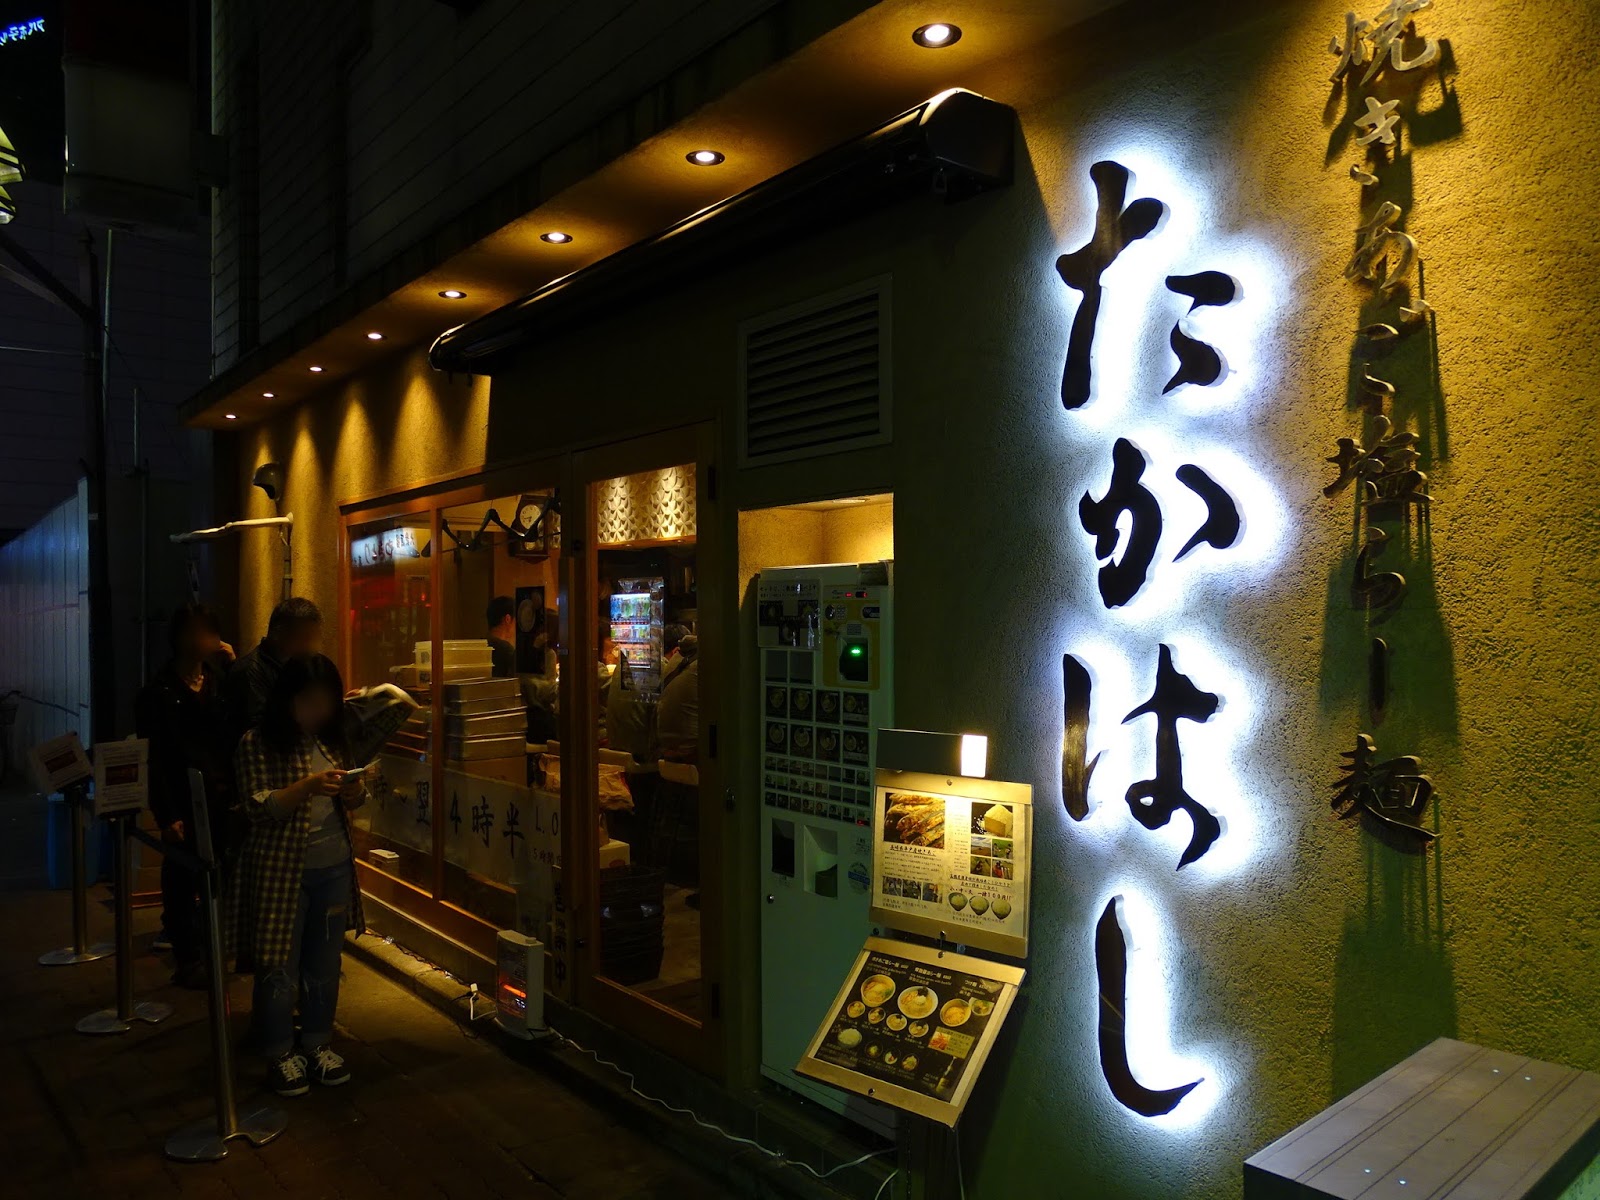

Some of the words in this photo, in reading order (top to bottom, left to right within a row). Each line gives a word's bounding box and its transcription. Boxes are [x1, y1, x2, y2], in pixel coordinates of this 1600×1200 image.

[1057, 159, 1243, 1118] たかはし
[1322, 0, 1441, 839] 焼きあご塩らー麺
